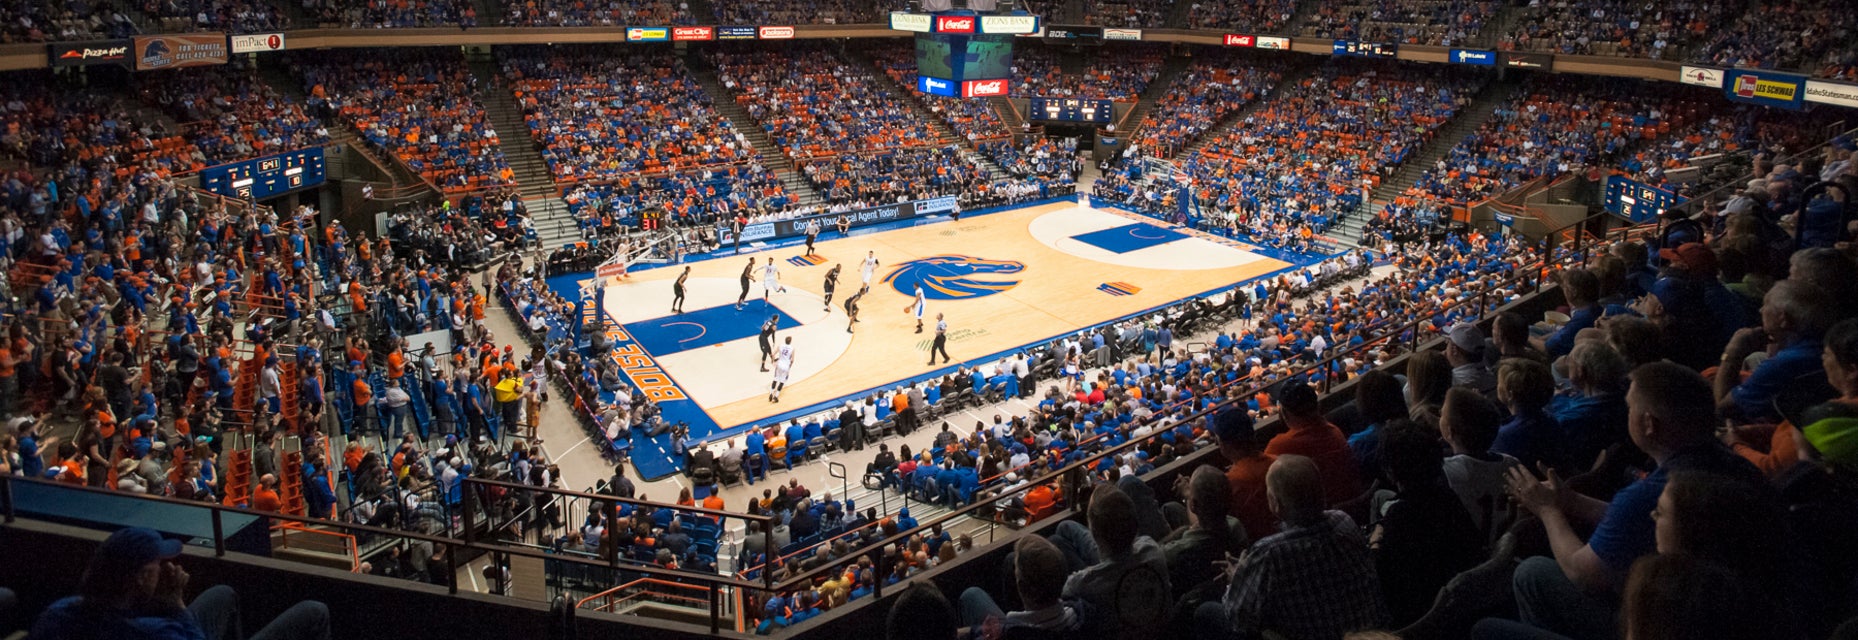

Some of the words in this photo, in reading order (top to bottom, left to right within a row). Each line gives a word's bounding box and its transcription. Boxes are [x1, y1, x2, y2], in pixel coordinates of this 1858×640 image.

[986, 17, 1008, 25] ZIONS
[694, 28, 709, 36] Clips
[82, 48, 109, 60] Pizza
[109, 46, 127, 57] Hut
[1756, 83, 1766, 93] LES
[1767, 85, 1794, 97] SCHWAB
[643, 219, 657, 230] 31
[821, 216, 838, 229] Your
[858, 210, 878, 223] Agent
[878, 206, 899, 219] Today!
[611, 343, 689, 402] BOISE
